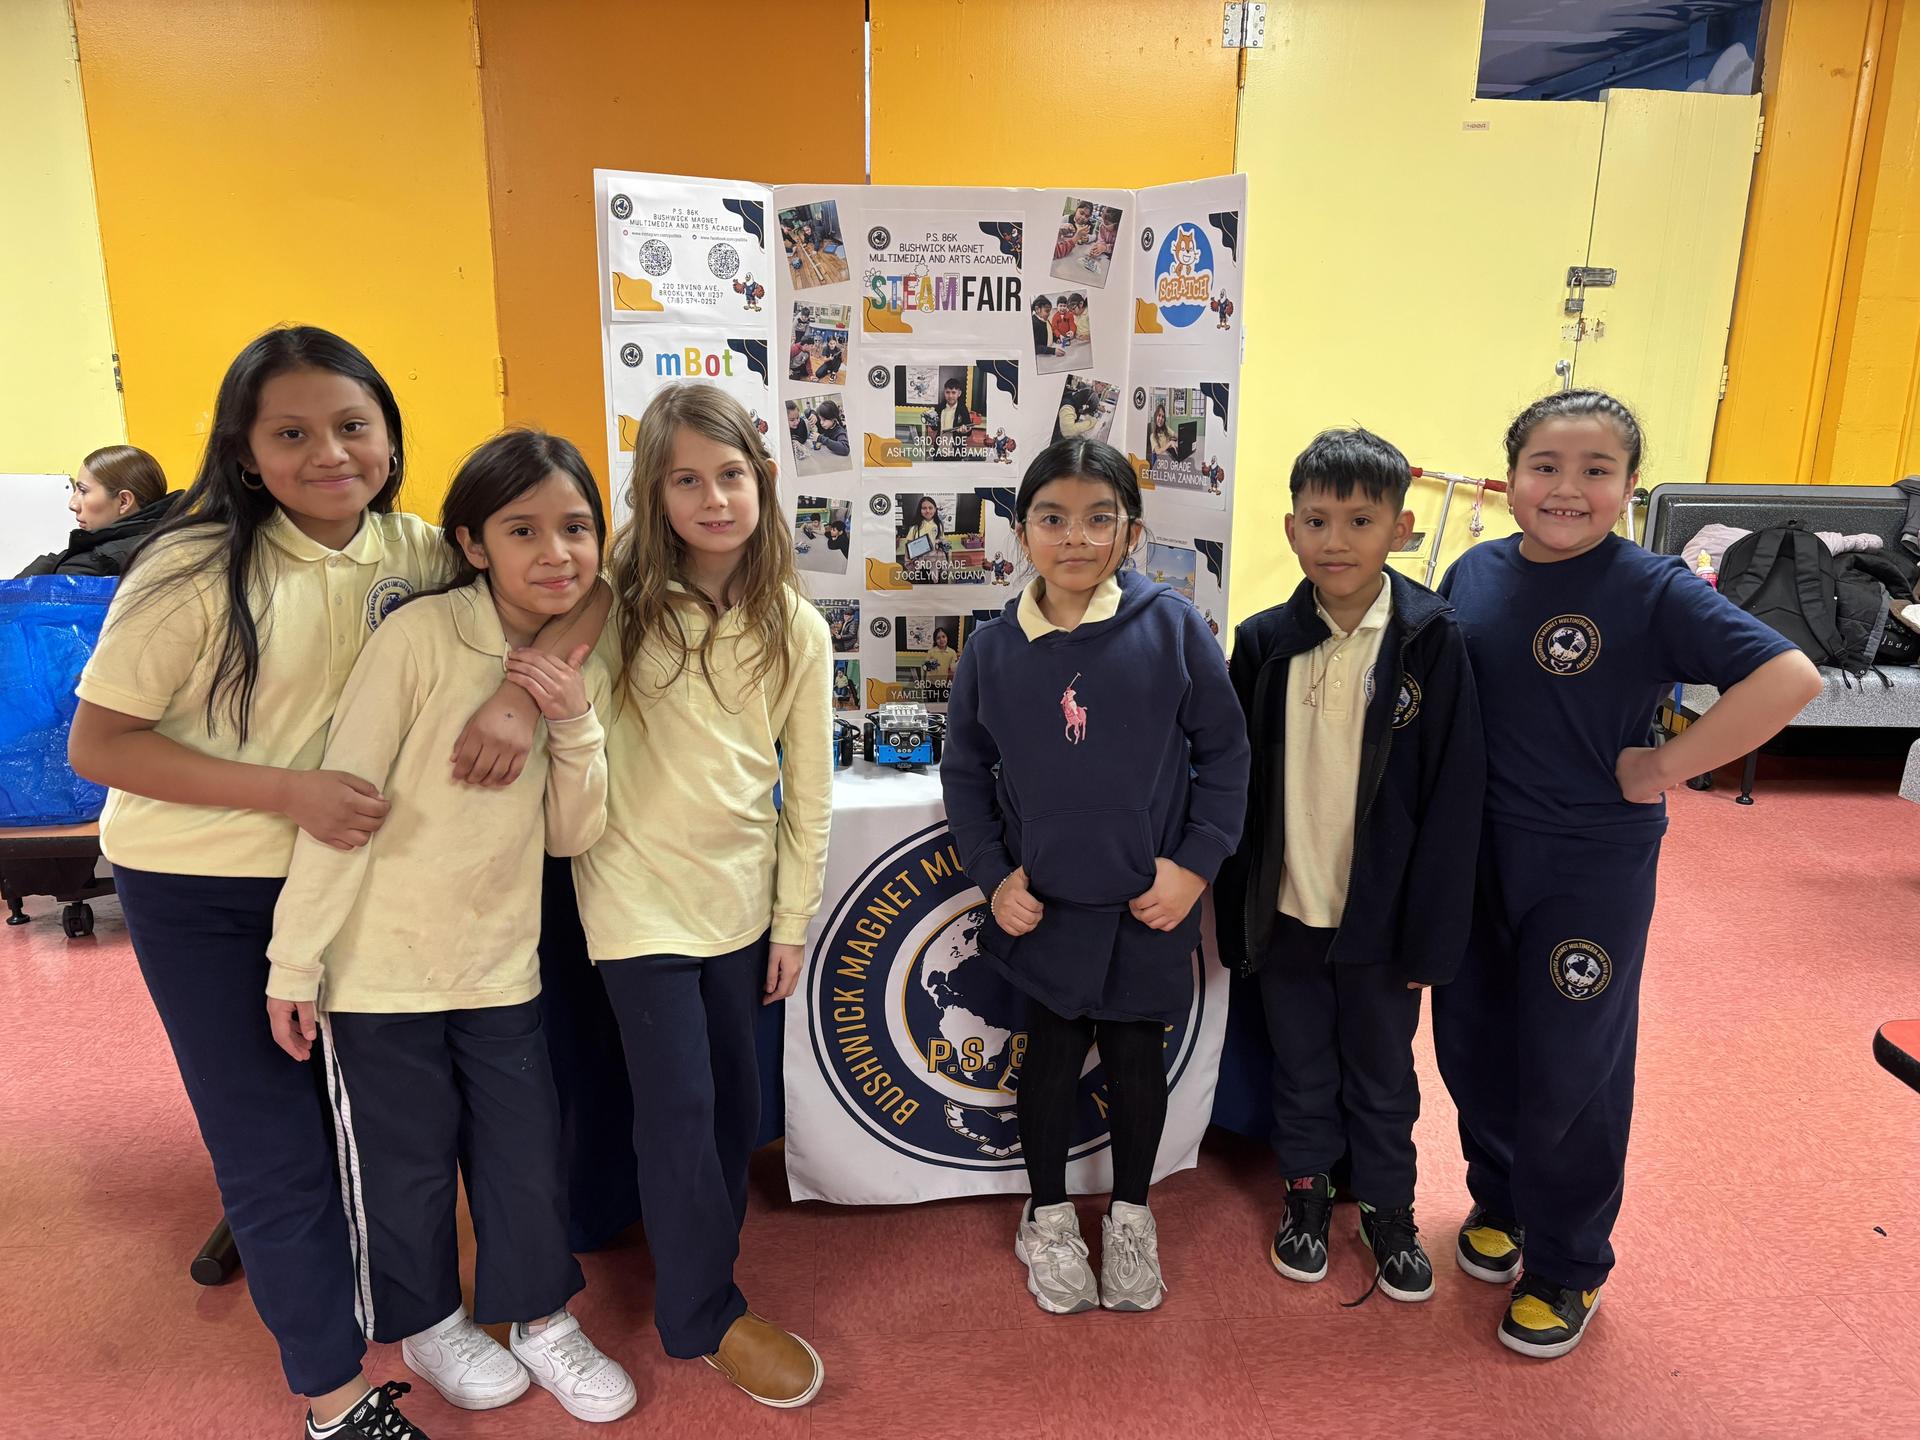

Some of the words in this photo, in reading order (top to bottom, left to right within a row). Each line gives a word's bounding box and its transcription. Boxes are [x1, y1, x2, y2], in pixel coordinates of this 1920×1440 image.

[686, 208, 699, 216] 86K
[653, 213, 689, 222] BUSHWICK
[629, 219, 673, 228] MULTIMEDIA
[692, 223, 709, 231] ARTS
[711, 225, 742, 233] ACADEMY
[926, 233, 940, 242] P.S.
[941, 233, 958, 242] 86K
[899, 243, 945, 253] BUSHWICK
[948, 244, 984, 253] MAGNET
[869, 253, 926, 263] MULTIMEDIA
[928, 254, 945, 264] AND
[948, 255, 970, 264] ARTS
[973, 255, 1014, 265] ACADEMY
[662, 282, 675, 290] 220
[677, 283, 702, 291] IRVING
[871, 275, 957, 311] STEAM
[962, 276, 1022, 311] FAIR
[656, 347, 733, 376] mBot
[914, 436, 932, 446] 3RD
[935, 436, 968, 446] GRADE
[886, 447, 926, 458] ASHTON
[1156, 459, 1169, 470] 3RD
[1170, 460, 1192, 473] GRADE
[914, 560, 932, 570] 3RD
[935, 560, 966, 570] GRADE
[894, 571, 938, 581] JOCELYN
[940, 571, 986, 581] CAGUANA
[914, 680, 932, 689] 3RD
[934, 680, 953, 689] GRA
[891, 690, 940, 699] YAMILETH
[836, 869, 922, 980] MAGNET
[833, 987, 920, 1126] BUSHWICK
[928, 1036, 996, 1073] P.S.
[1293, 1177, 1314, 1189] 2K
